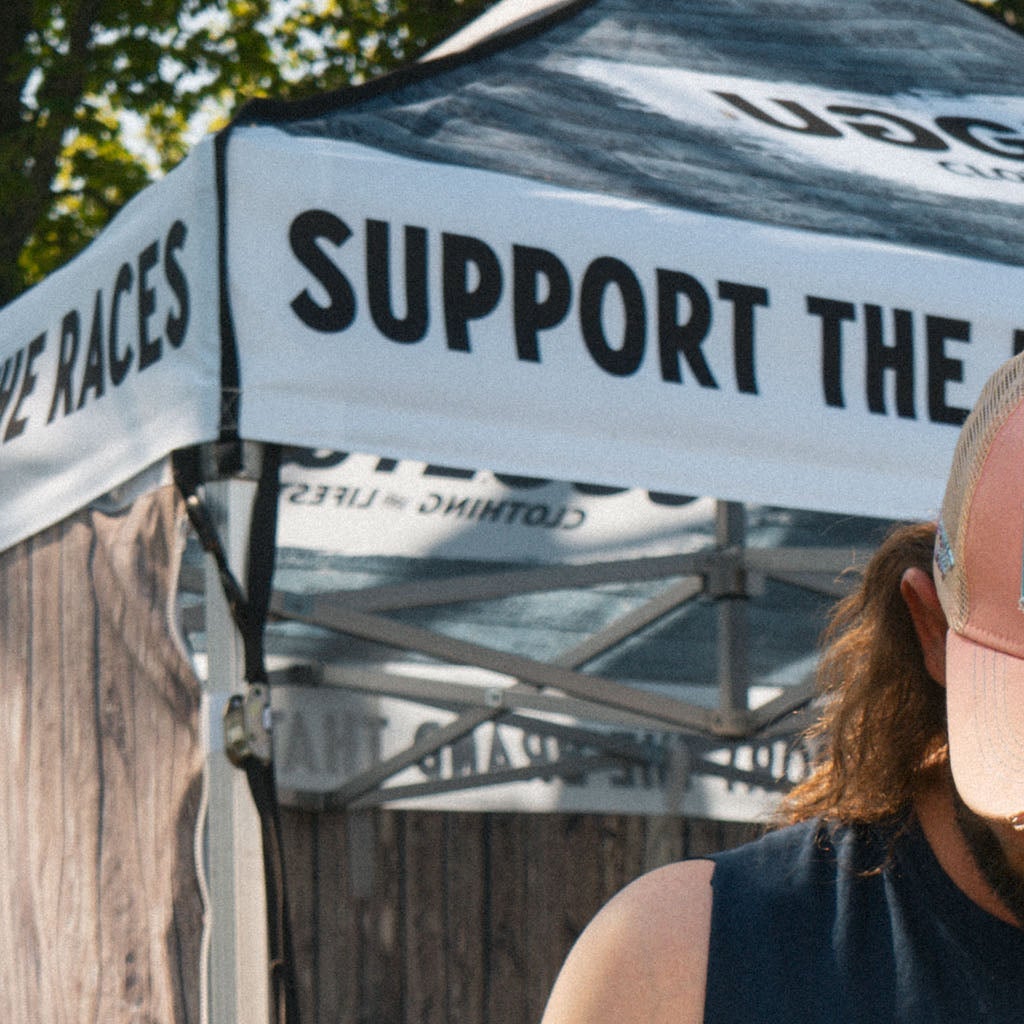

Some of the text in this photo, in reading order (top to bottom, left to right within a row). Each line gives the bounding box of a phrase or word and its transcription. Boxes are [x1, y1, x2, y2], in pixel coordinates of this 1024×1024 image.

[47, 218, 191, 427] RACES
[287, 208, 769, 395] SUPPORT
[805, 294, 972, 428] THE
